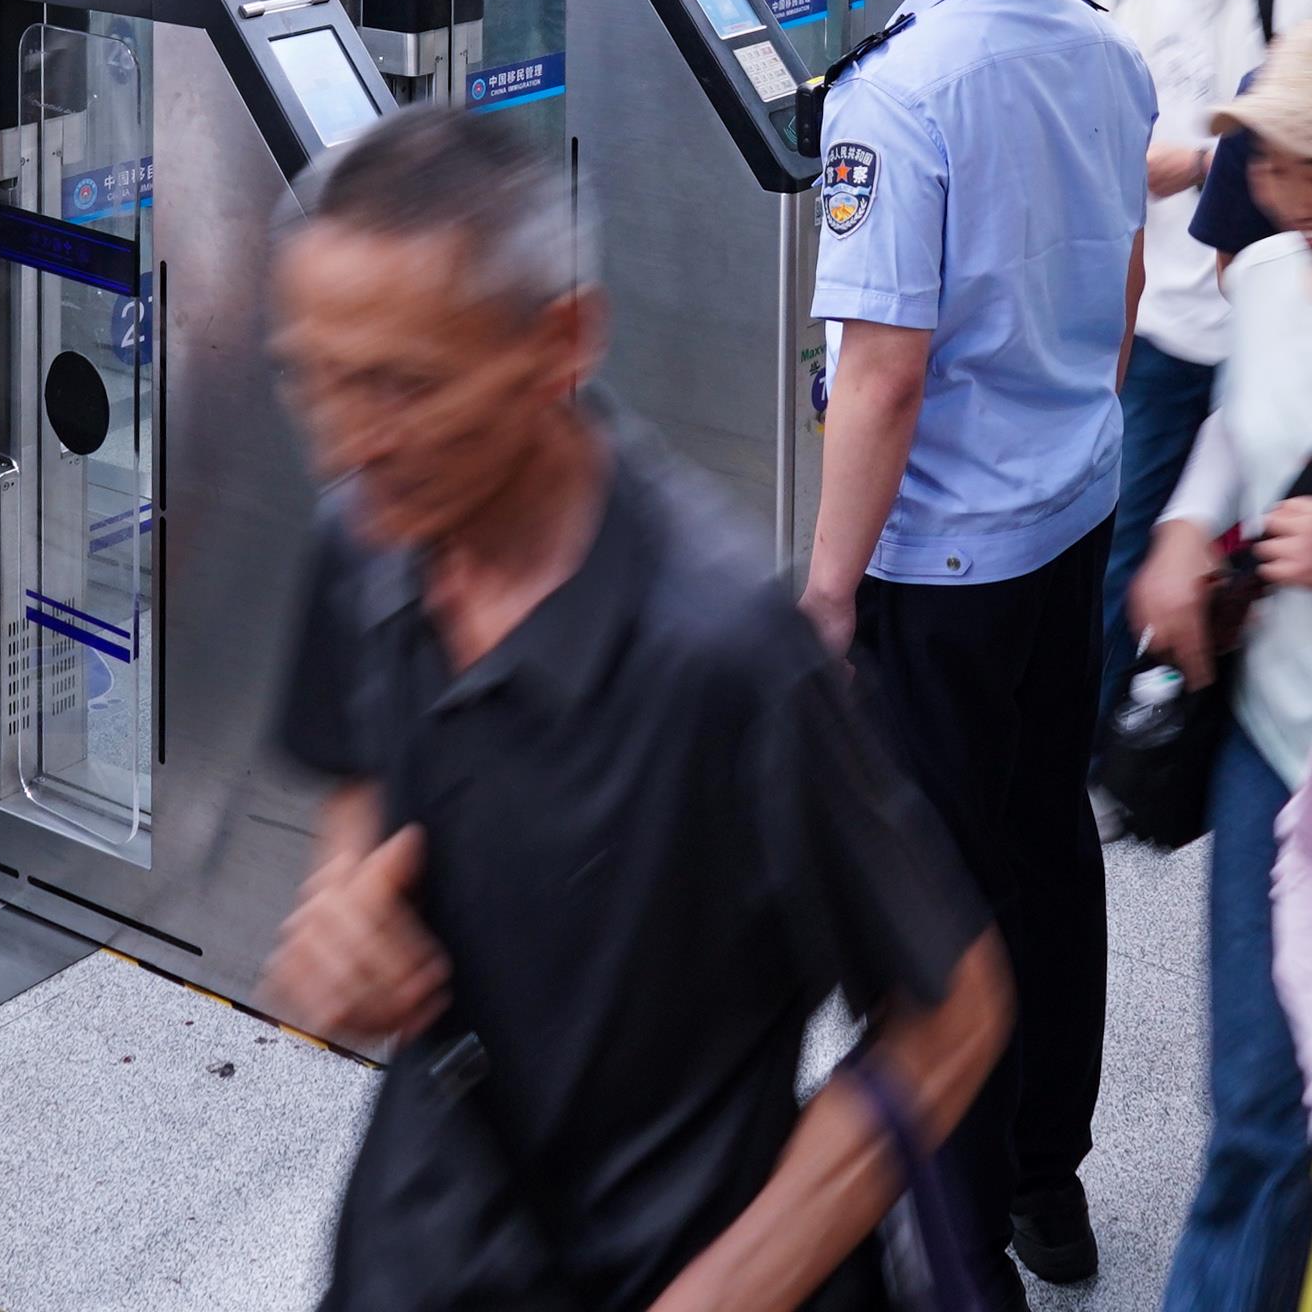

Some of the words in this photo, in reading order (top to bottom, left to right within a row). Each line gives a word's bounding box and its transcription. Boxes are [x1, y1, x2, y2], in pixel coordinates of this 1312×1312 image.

[489, 64, 543, 88] 中国移民管理
[828, 146, 873, 166] 华人民共和国
